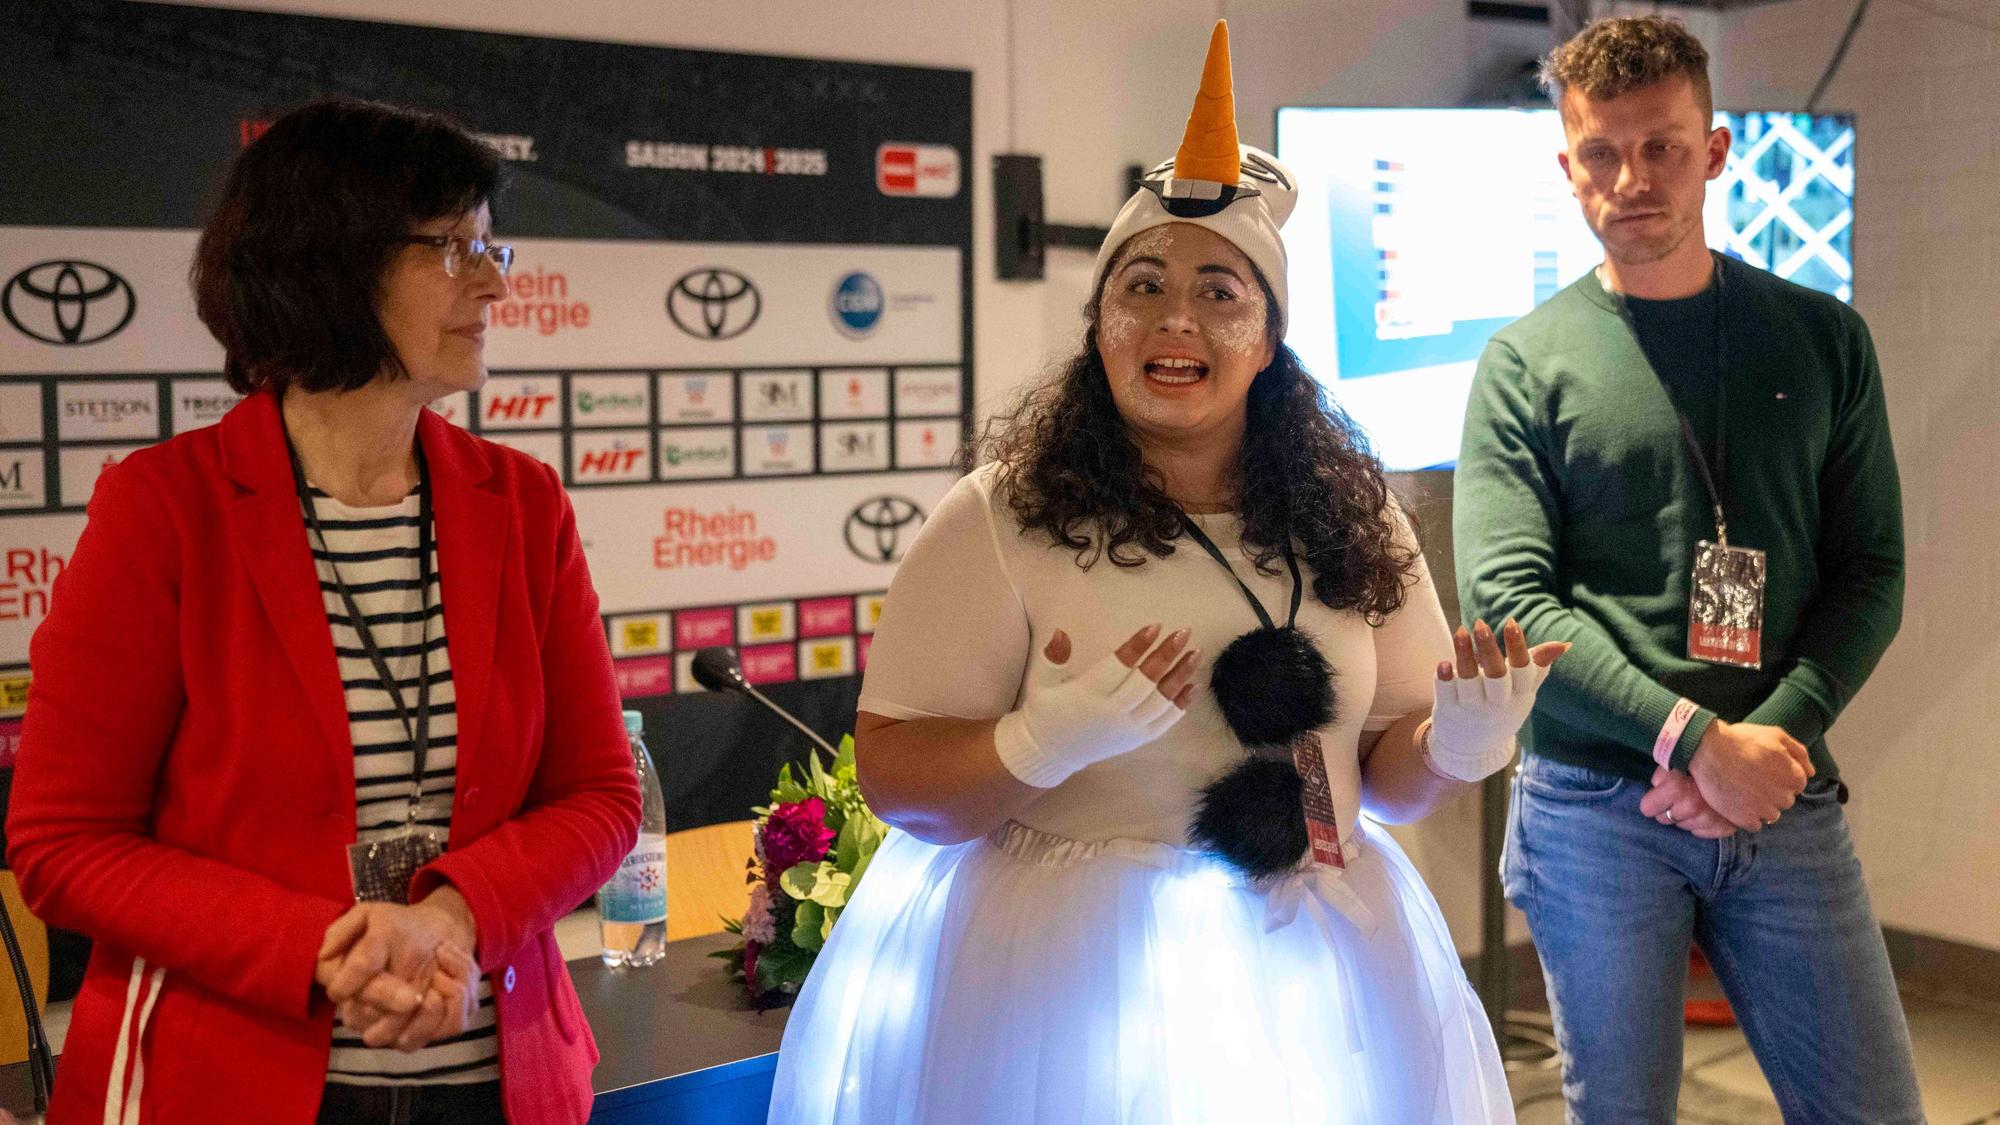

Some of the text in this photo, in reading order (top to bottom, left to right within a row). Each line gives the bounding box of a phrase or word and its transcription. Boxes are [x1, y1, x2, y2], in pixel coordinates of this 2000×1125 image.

[64, 400, 153, 416] STETSON
[486, 395, 555, 419] HIT
[579, 449, 643, 473] HIT
[664, 504, 757, 539] Rhein
[7, 547, 64, 584] Rh
[652, 536, 777, 571] Energie
[0, 584, 48, 619] En
